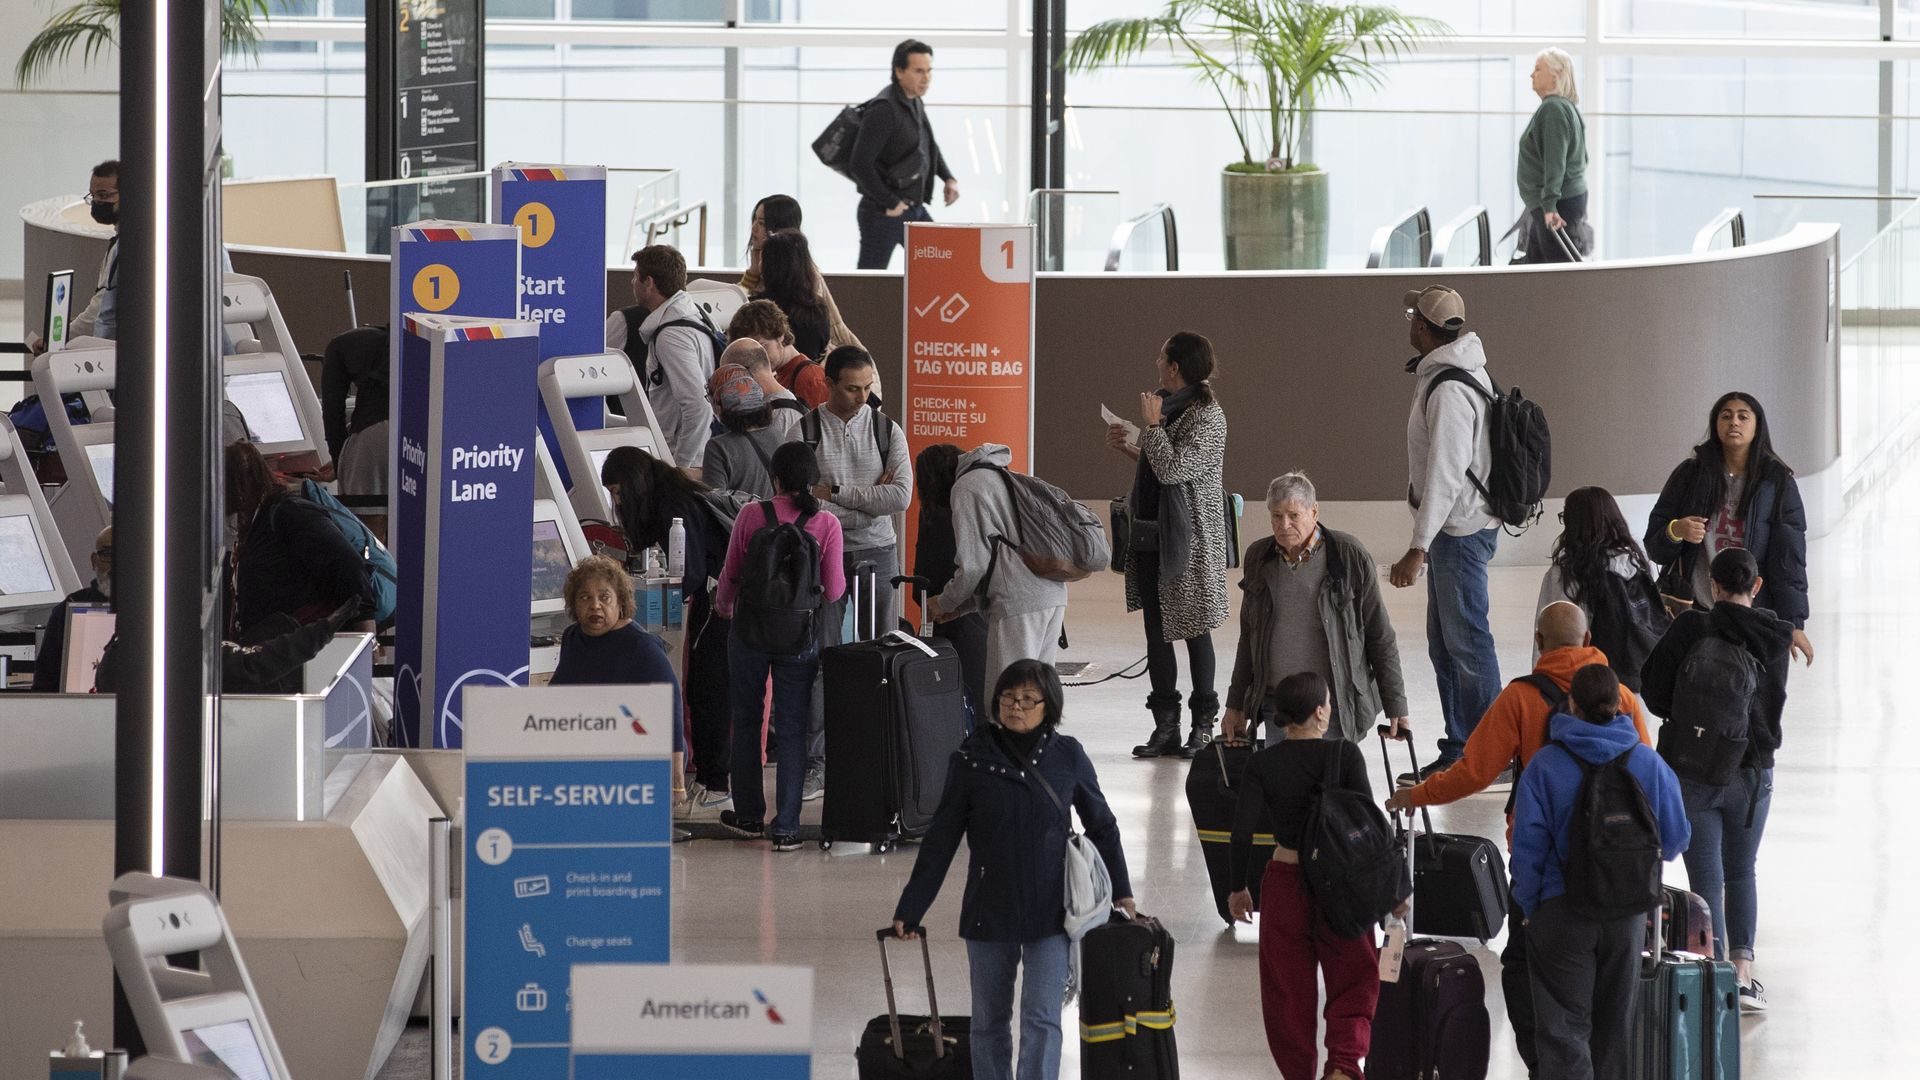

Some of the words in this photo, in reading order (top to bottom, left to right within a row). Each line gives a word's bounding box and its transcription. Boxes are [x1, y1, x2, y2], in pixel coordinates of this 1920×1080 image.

[400, 8, 409, 32] 2
[400, 96, 407, 119] 1
[401, 156, 410, 179] 0
[528, 214, 538, 236] 1
[913, 245, 953, 260] jetBlue
[1001, 240, 1014, 269] 1
[429, 276, 440, 299] 1
[914, 341, 988, 357] CHECK-IN
[914, 360, 942, 374] TAG
[945, 361, 988, 376] YOUR
[991, 361, 1023, 376] BAG
[913, 397, 967, 410] CHECK-IN
[913, 411, 967, 424] ETIQUETE
[970, 413, 986, 424] SU
[913, 424, 968, 437] EQUIPAJE
[402, 436, 426, 475] Priority
[452, 443, 524, 472] Priority
[402, 468, 417, 497] Lane
[451, 479, 497, 502] Lane
[523, 714, 617, 732] American
[487, 784, 655, 807] SELF-SERVICE
[490, 843, 497, 859] 1
[566, 872, 611, 883] Check-in
[612, 872, 632, 883] and
[566, 887, 591, 899] print
[592, 887, 638, 899] boarding
[639, 888, 662, 899] pass
[566, 936, 604, 949] Change
[606, 937, 632, 947] seats
[639, 998, 750, 1020] American
[488, 1042, 499, 1058] 2
